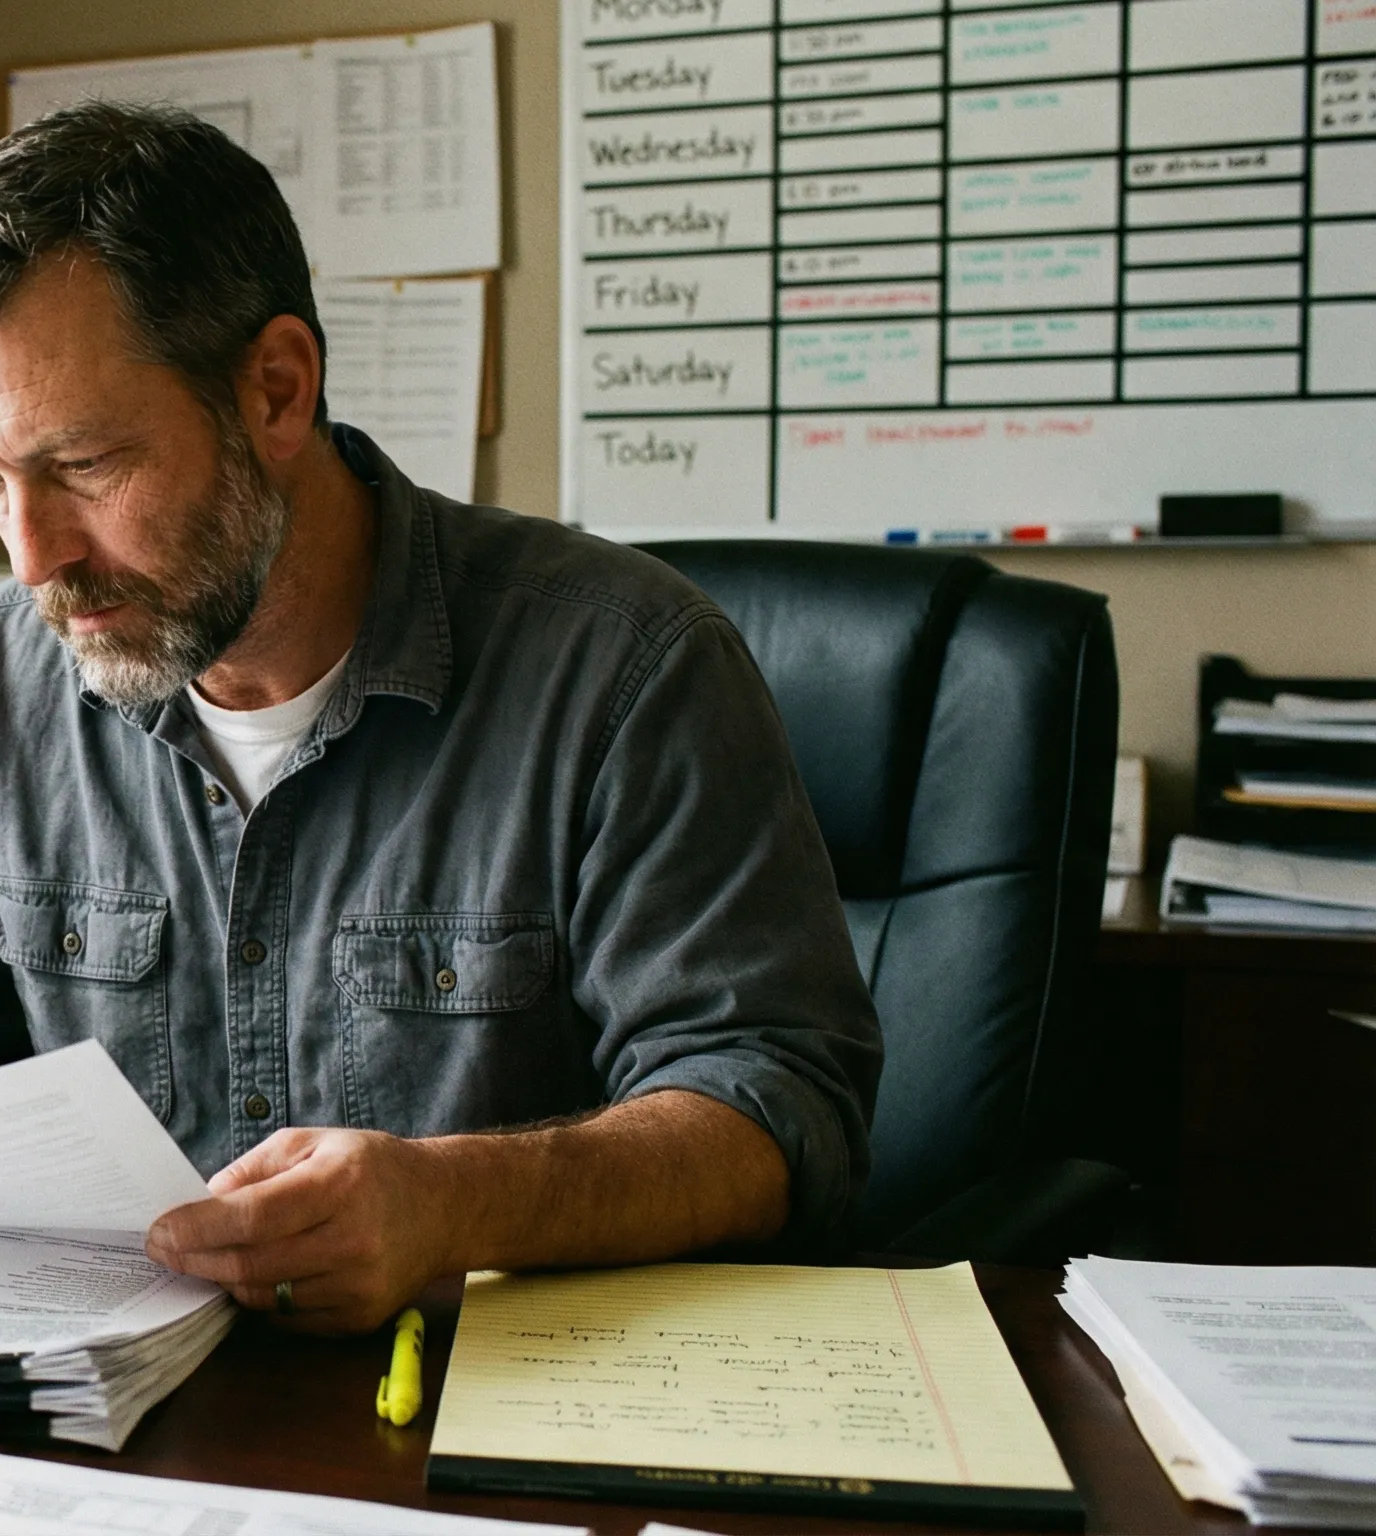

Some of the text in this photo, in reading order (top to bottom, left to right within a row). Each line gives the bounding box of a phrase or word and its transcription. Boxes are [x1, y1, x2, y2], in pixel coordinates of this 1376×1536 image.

[589, 55, 714, 99] Tuesday
[588, 125, 756, 168] Wednesday
[589, 202, 731, 246] Thursday
[594, 274, 700, 319] Friday
[591, 350, 734, 396] Saturday
[594, 430, 698, 476] Today
